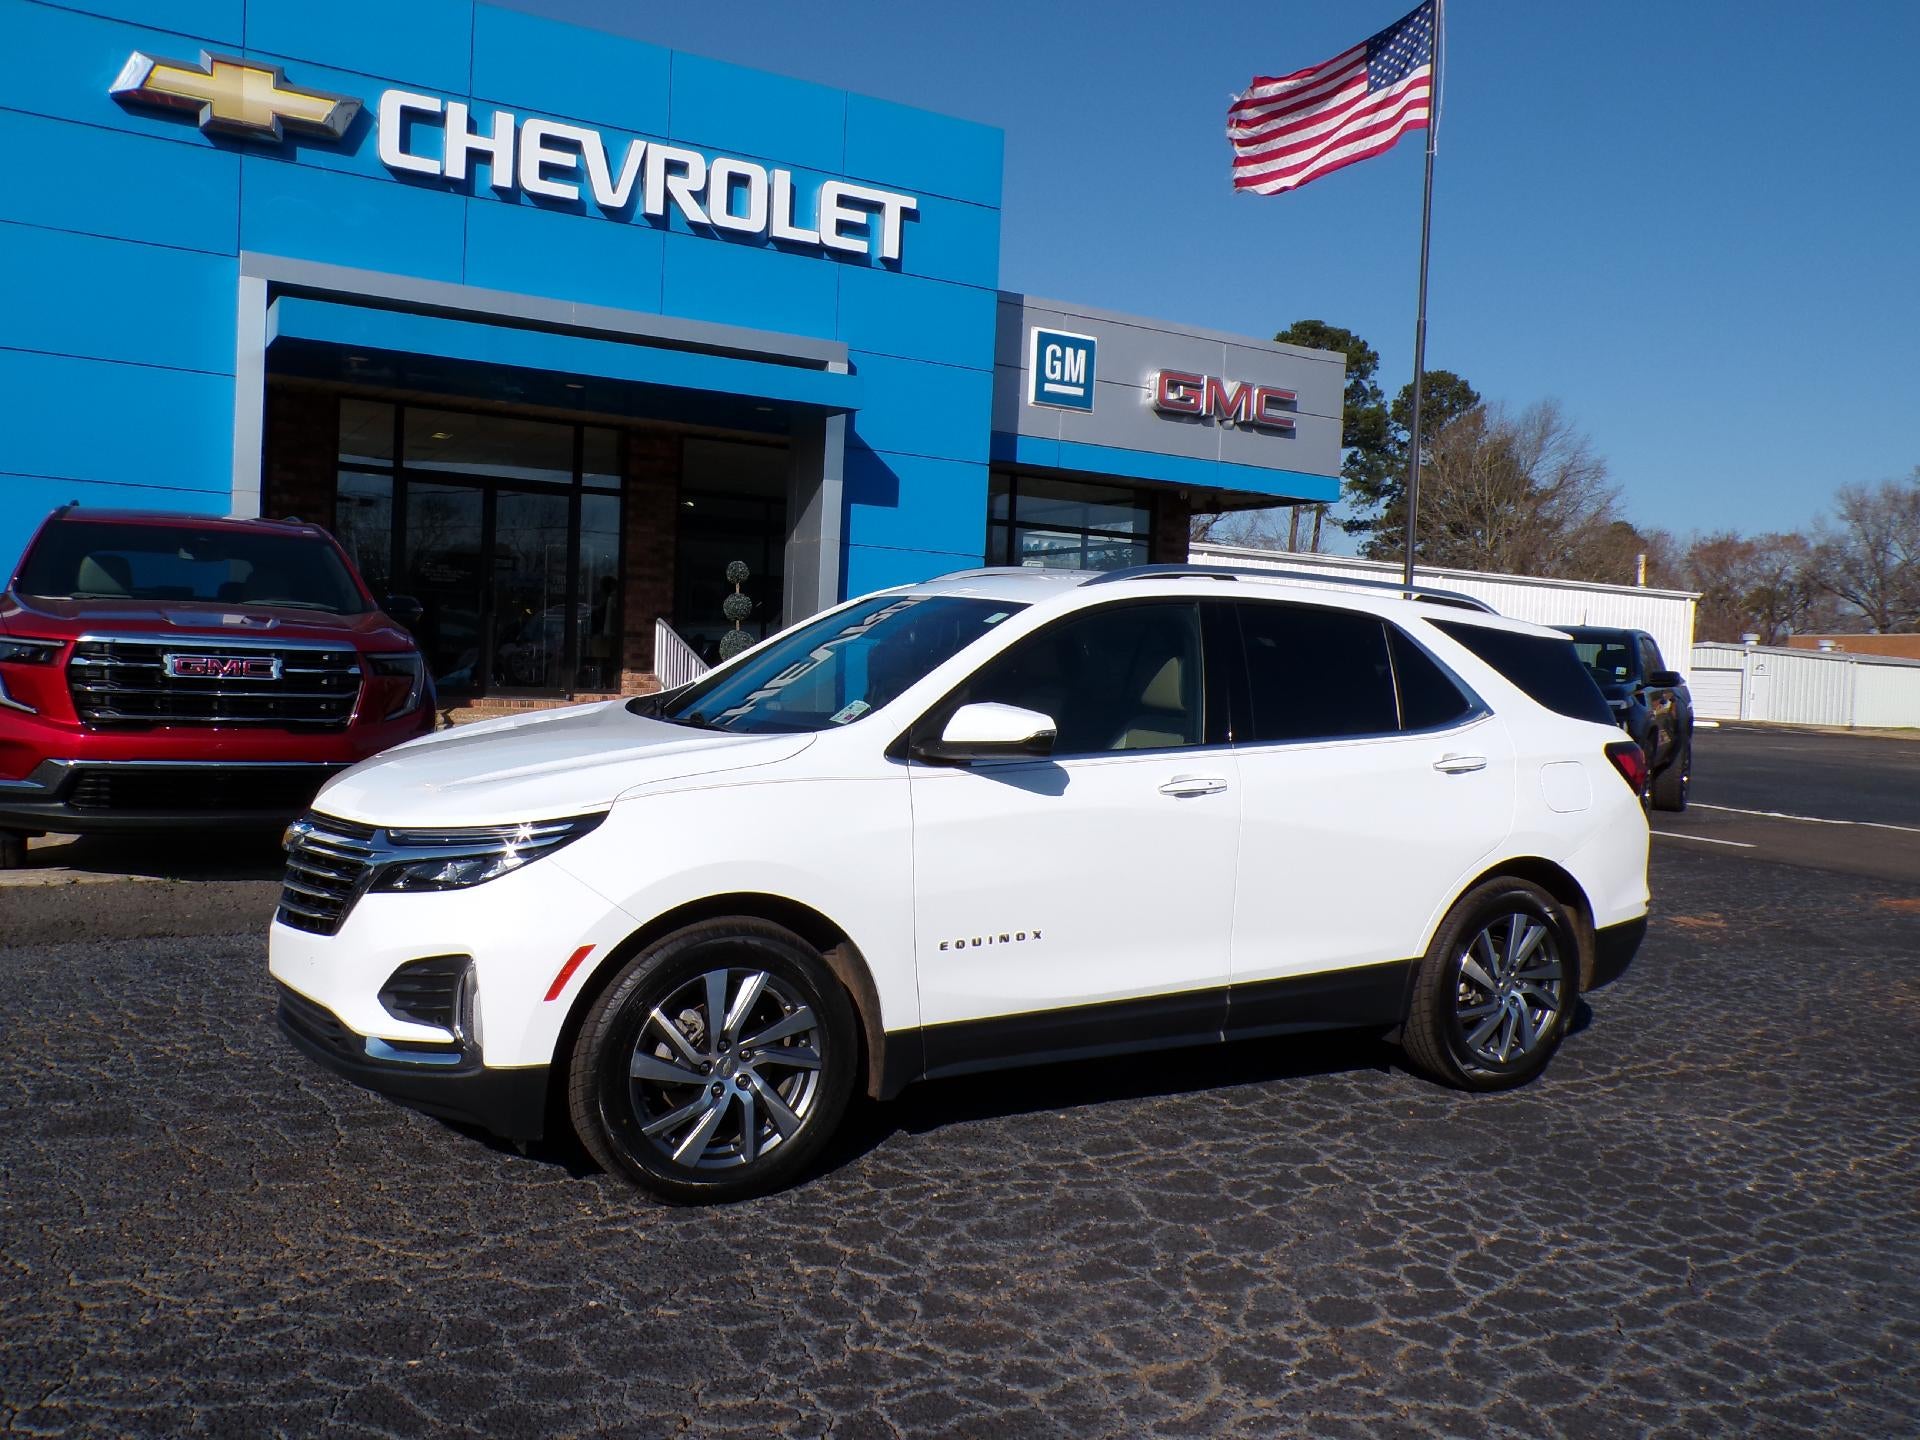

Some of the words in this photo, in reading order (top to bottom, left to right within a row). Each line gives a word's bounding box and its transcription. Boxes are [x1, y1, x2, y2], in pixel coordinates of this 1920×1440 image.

[379, 89, 918, 260] CHEVROLET
[1045, 343, 1086, 385] GM
[1154, 370, 1298, 430] GMC
[175, 657, 273, 677] GMC
[939, 929, 1043, 951] EQUINOX
